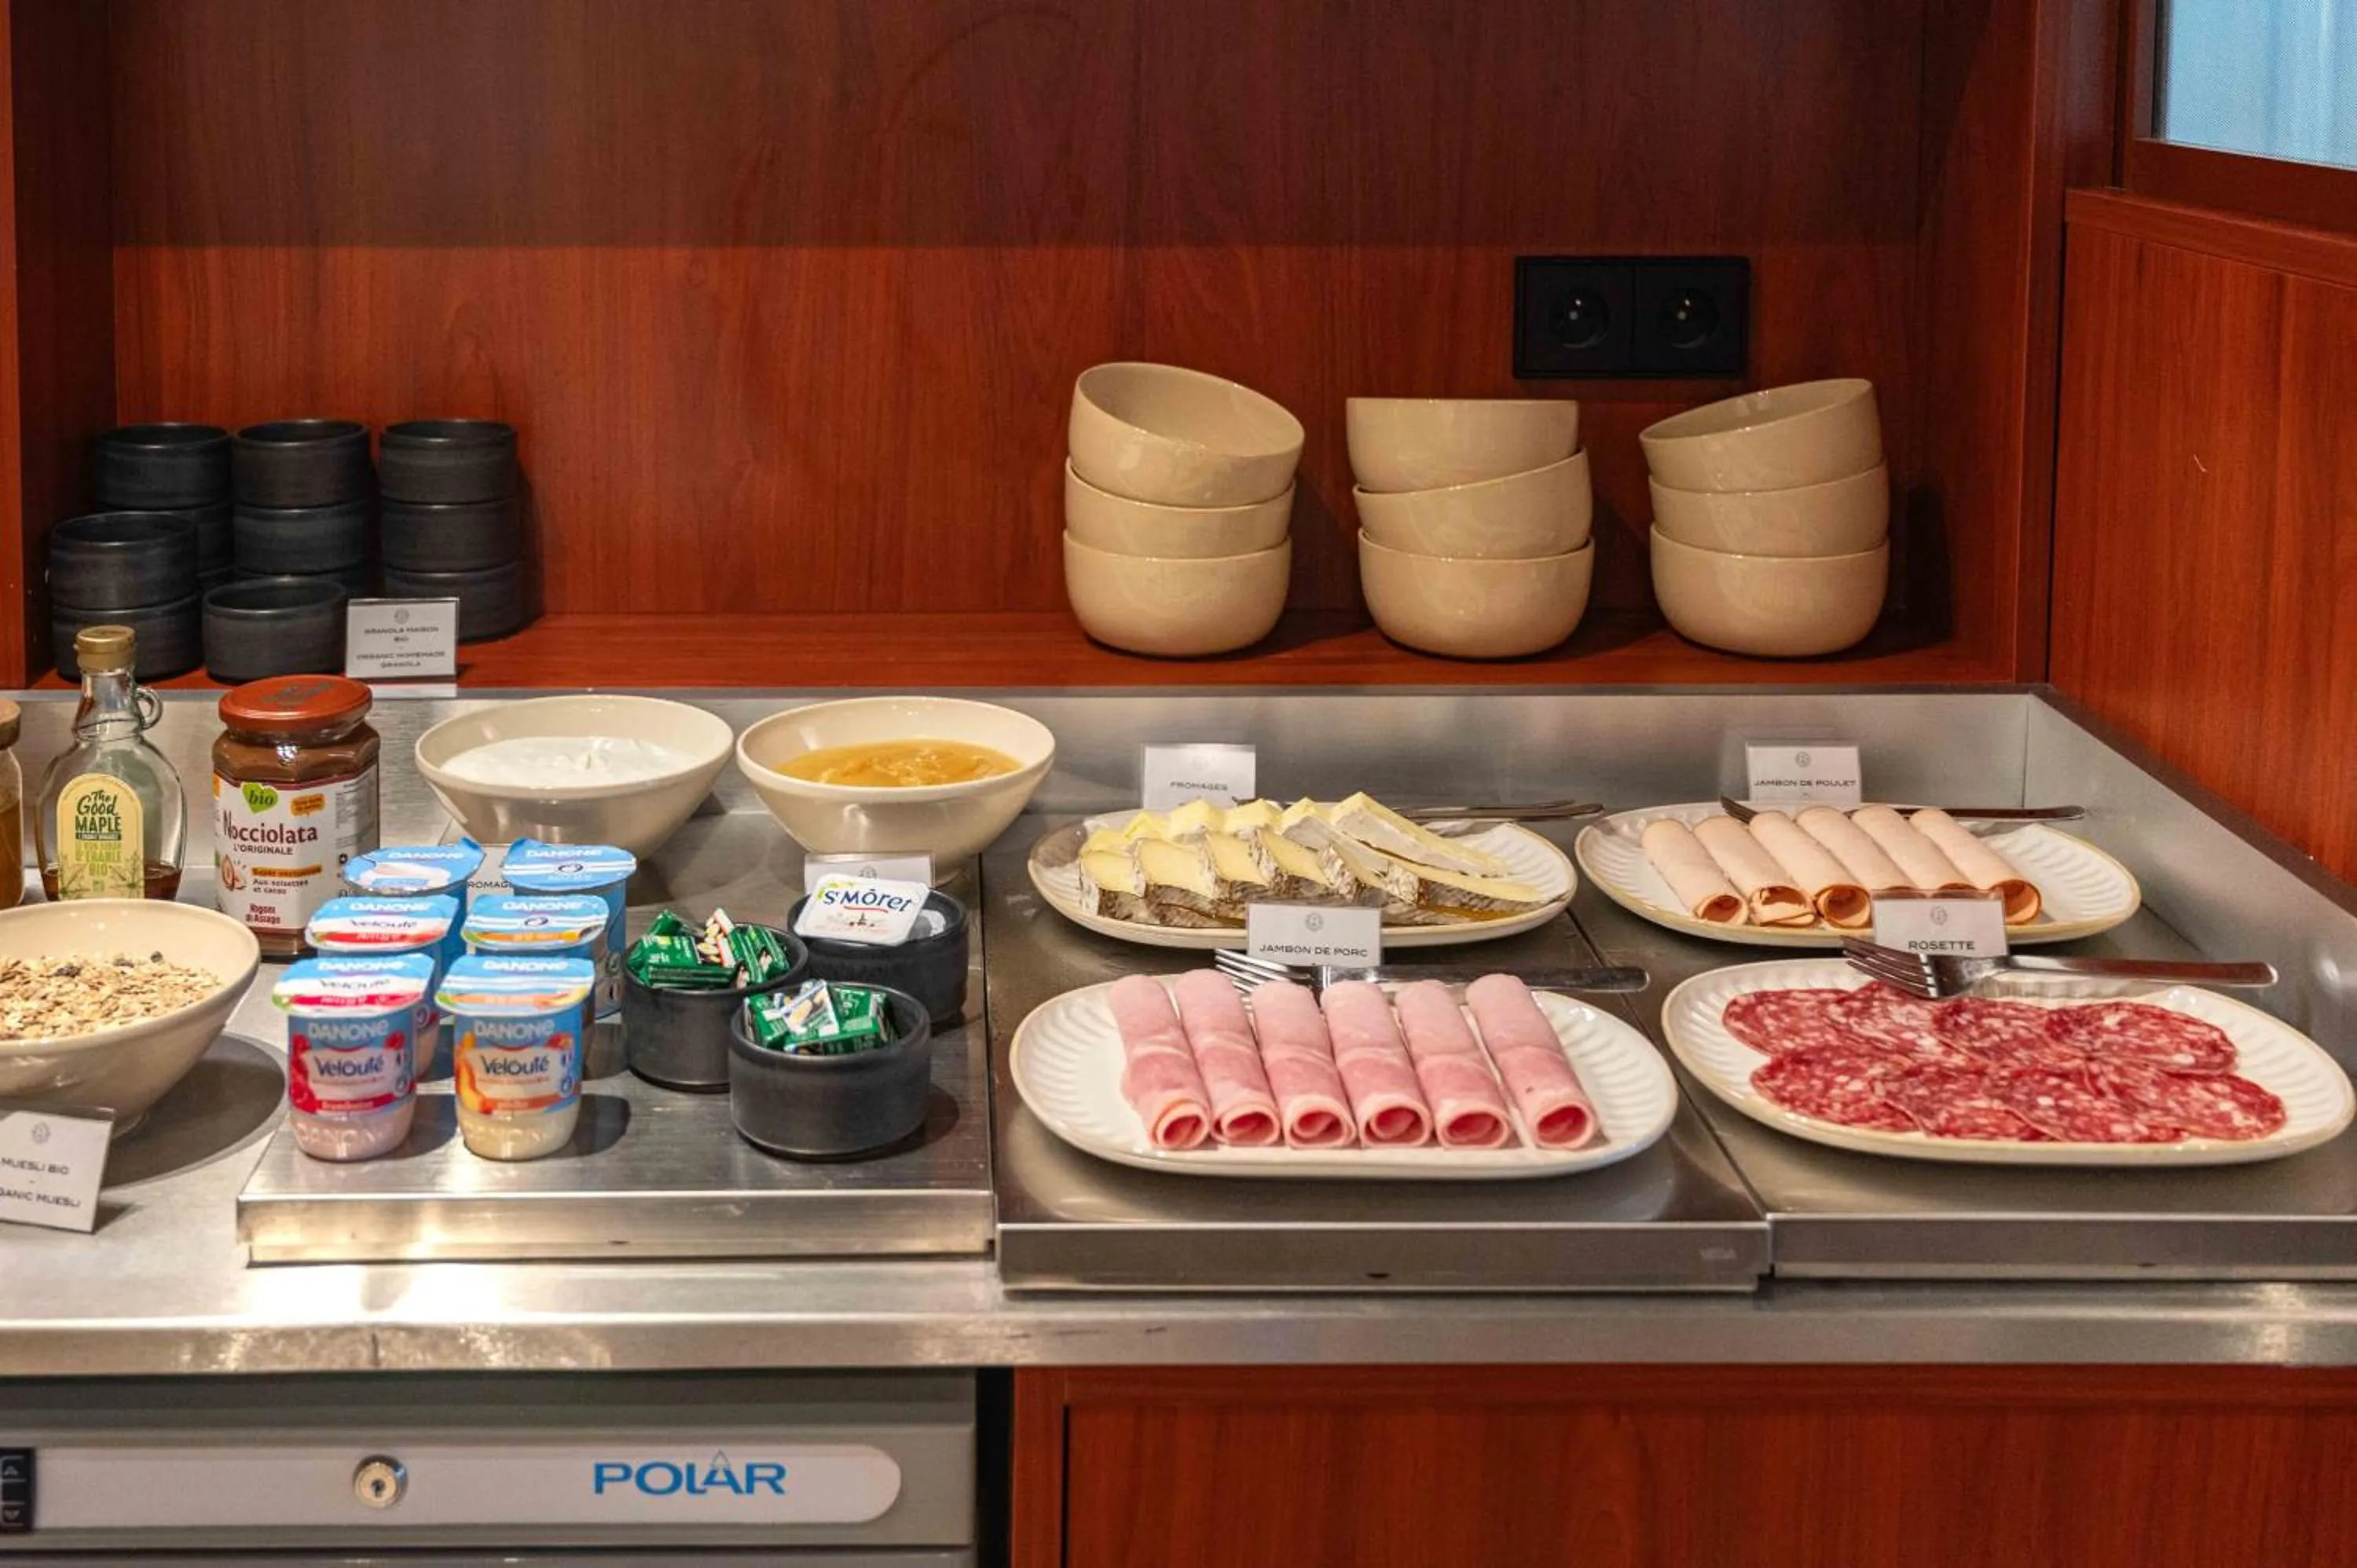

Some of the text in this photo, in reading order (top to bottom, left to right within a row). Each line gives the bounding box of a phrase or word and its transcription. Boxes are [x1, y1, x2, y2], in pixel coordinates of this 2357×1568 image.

[1170, 781, 1228, 791] FROMAGES
[90, 789, 111, 802] The
[249, 789, 275, 805] bio
[76, 794, 119, 816] Good
[75, 816, 122, 832] MAPLE
[223, 809, 317, 844] Nocciolata
[233, 843, 293, 855] L'ORIGINALE
[1259, 944, 1368, 958] JAMBON DE PORC
[1908, 940, 1975, 950] ROSETTE
[314, 1055, 384, 1077] Velouté
[480, 1053, 549, 1076] Velouté
[1, 1157, 70, 1174] MUESLI BIO
[35, 1193, 82, 1207] MUESLI
[594, 1449, 787, 1495] POLAR
